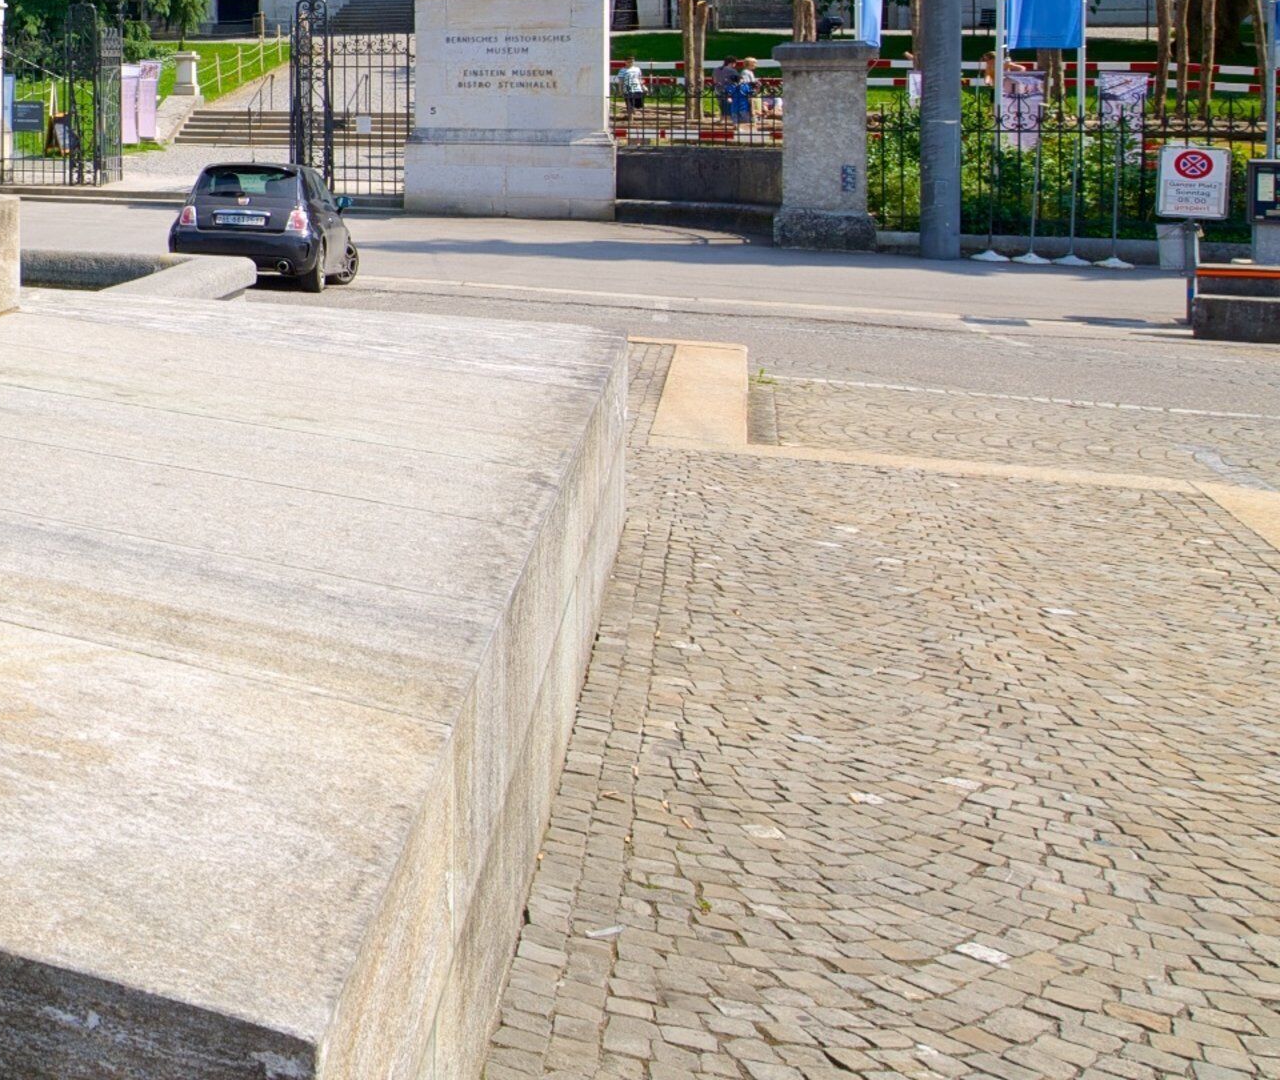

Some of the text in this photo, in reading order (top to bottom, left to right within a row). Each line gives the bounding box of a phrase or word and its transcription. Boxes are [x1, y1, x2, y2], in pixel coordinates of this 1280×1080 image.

[445, 35, 572, 44] BERNISCHES HISTORISCHES
[486, 47, 529, 55] MUSEUM
[463, 69, 553, 77] EINSTEIN MUSEUM
[457, 81, 558, 89] BISTRO STEINHALLE
[1176, 189, 1210, 197] Sonntag
